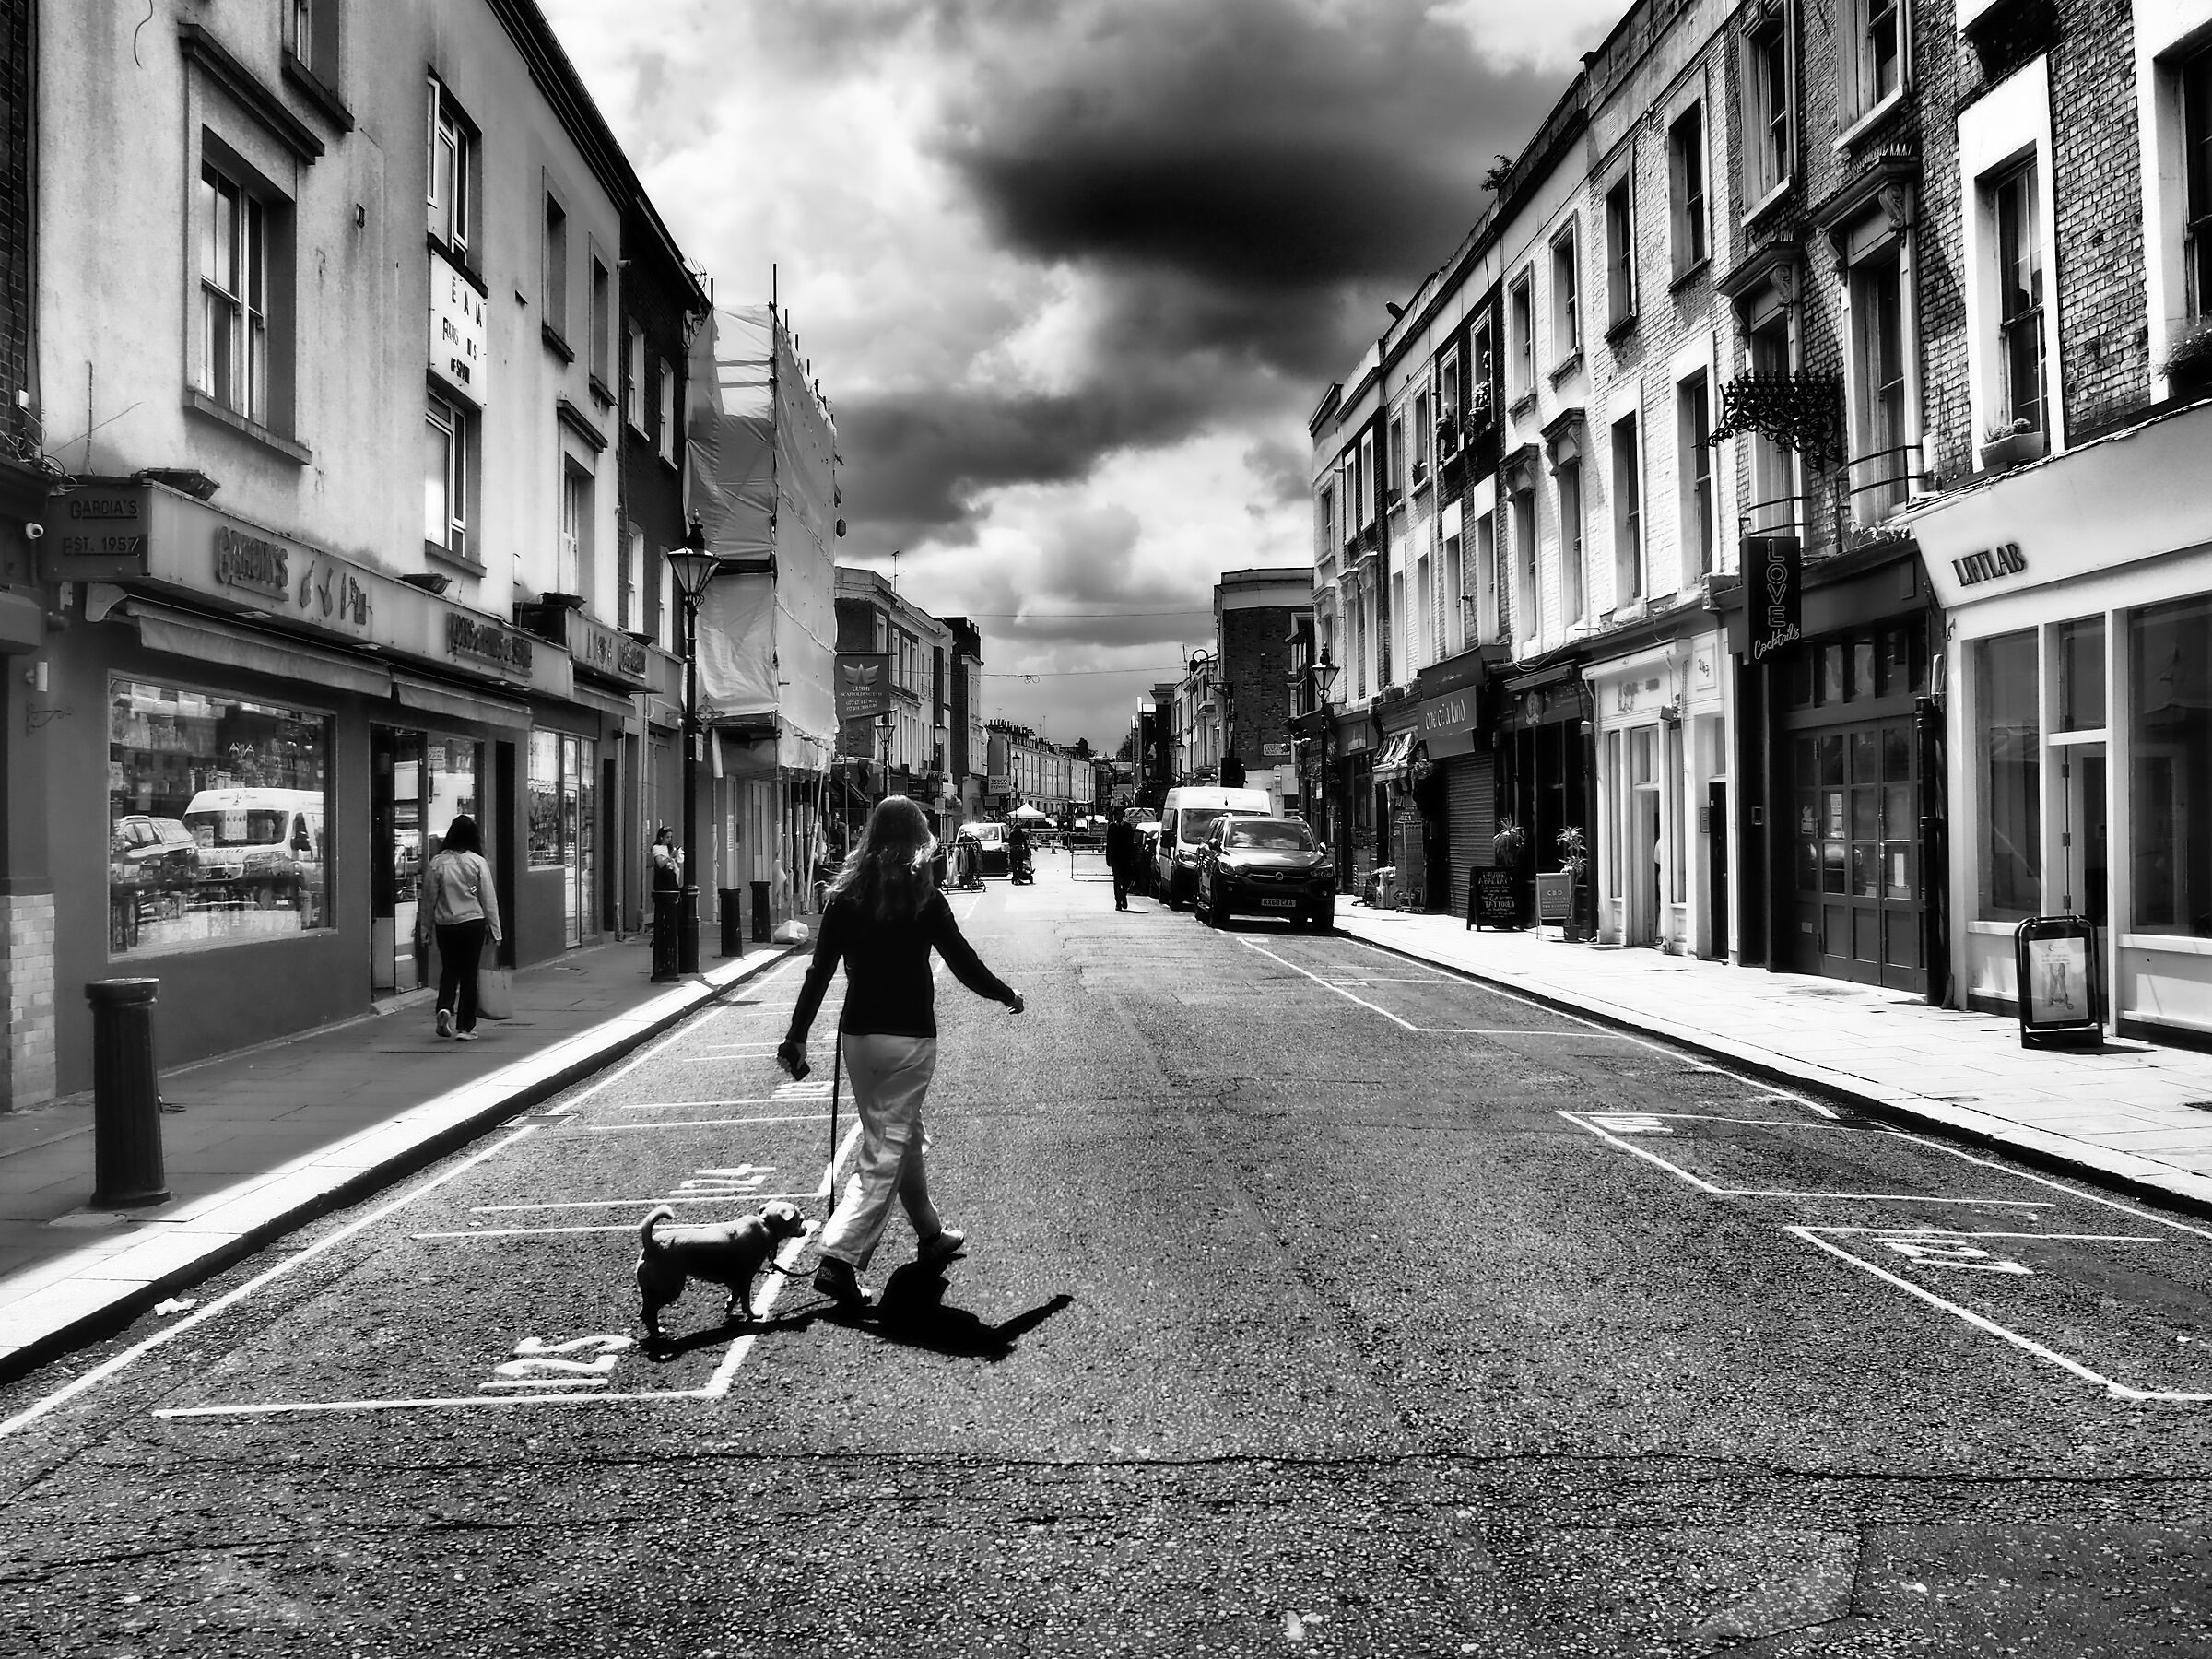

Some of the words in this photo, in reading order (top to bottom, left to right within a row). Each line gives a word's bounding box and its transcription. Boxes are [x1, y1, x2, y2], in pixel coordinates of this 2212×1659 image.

[71, 500, 137, 519] GARCIA'S
[63, 537, 94, 555] EST.
[102, 537, 138, 553] 1957
[1951, 542, 2028, 587] LIFTLAB
[1766, 538, 1788, 628] LOVE
[1754, 623, 1800, 660] Cocktails
[669, 1163, 777, 1195] 124
[1871, 1237, 2035, 1275] 127
[477, 1335, 633, 1388] 125
